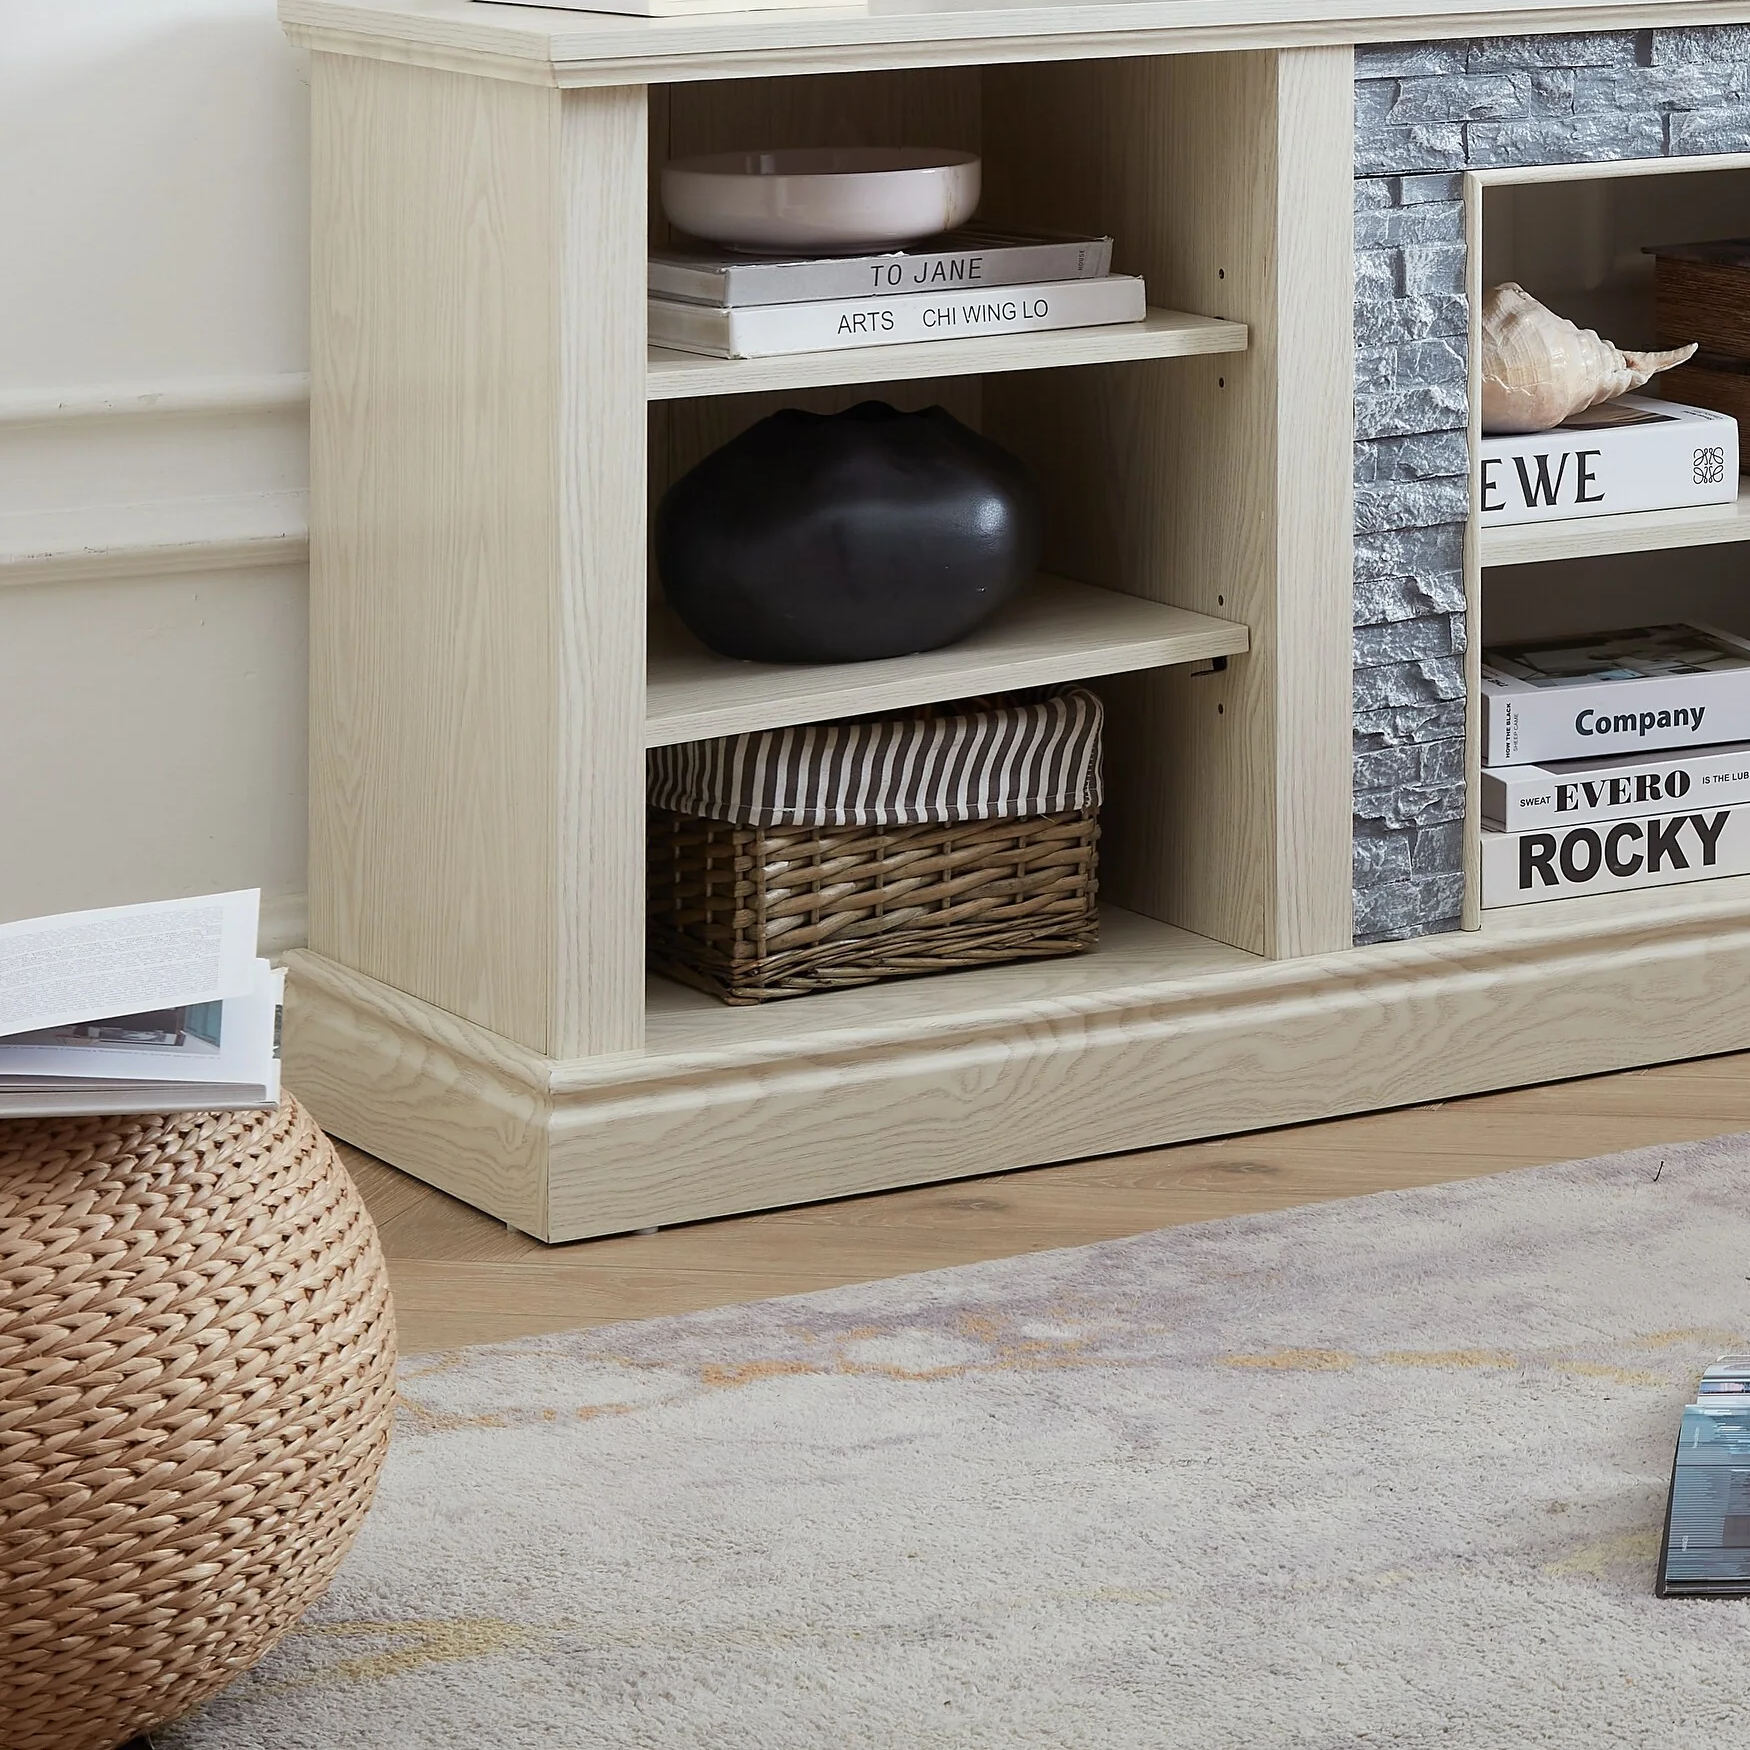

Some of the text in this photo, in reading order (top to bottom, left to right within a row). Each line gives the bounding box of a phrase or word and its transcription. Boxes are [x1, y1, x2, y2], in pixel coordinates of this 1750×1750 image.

[870, 257, 984, 288] TO JANE
[837, 297, 1050, 335] ARTS CHI WING LO
[1481, 450, 1606, 511] EWE
[1575, 702, 1706, 738] Company
[1554, 769, 1691, 813] EVERO
[1702, 775, 1711, 785] IS
[1713, 772, 1730, 784] THE
[1520, 795, 1551, 808] SWEAT
[1519, 810, 1732, 890] ROCKY
